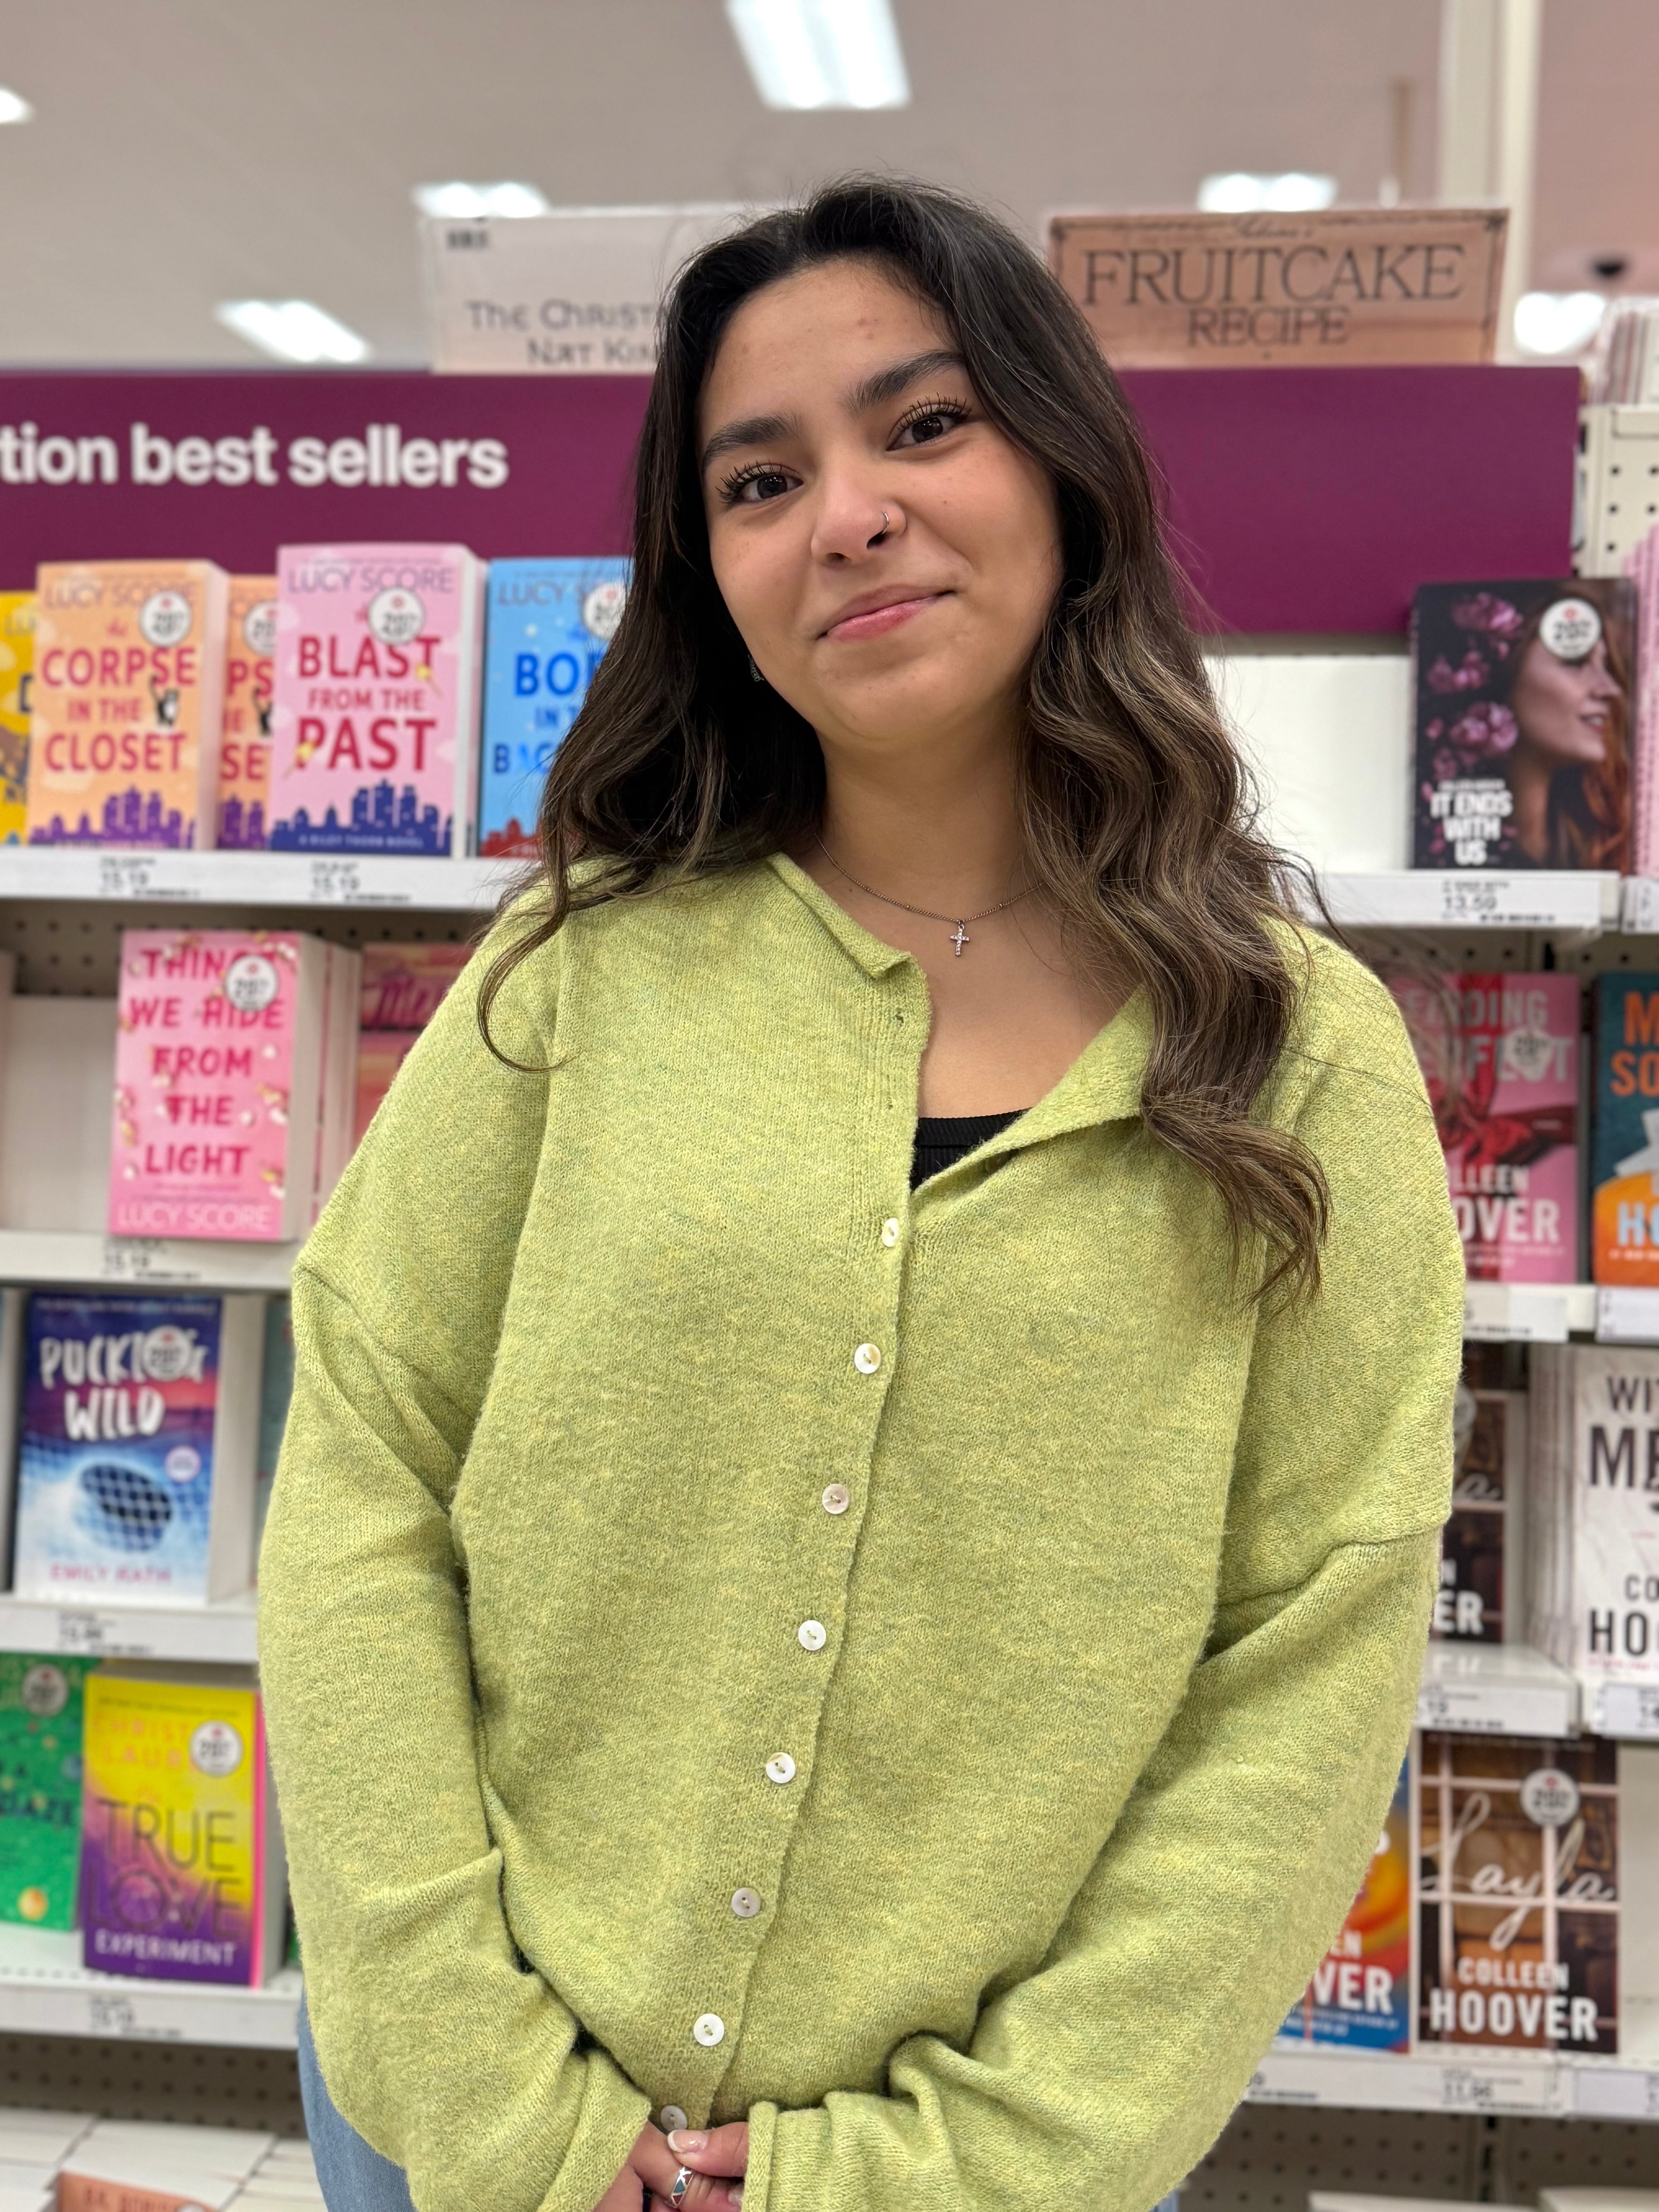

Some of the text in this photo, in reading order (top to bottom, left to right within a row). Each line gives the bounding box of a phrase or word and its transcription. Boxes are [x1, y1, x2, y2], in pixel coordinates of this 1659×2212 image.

[1084, 243, 1466, 307] FRUITCAKE
[1187, 304, 1351, 347] RECIPE
[131, 422, 279, 486] best
[288, 423, 510, 489] sellers
[288, 566, 454, 594] LUCY SCORE
[497, 580, 567, 606] LUCY
[42, 647, 196, 688] CORPSE
[298, 634, 442, 679] BLAST
[67, 697, 142, 724] IN THE
[308, 689, 426, 711] FROM THE
[535, 706, 560, 729] IN
[44, 732, 187, 772] CLOSET
[298, 717, 436, 772] PAST
[1430, 790, 1514, 819] IT ENDS
[1442, 816, 1501, 842] WITH
[1454, 838, 1488, 866] US
[140, 949, 275, 979] THIN
[130, 998, 181, 1028] WE
[151, 1047, 254, 1078] FROM
[163, 1095, 235, 1126] THE
[144, 1145, 250, 1177] LIGHT
[118, 1202, 272, 1232] LUCY SCORE
[39, 1327, 208, 1390] PUCKI
[64, 1386, 166, 1442] WILD
[1589, 1608, 1659, 1657] HO
[97, 1798, 235, 1872] TRUE
[1419, 1791, 1617, 1952] Layla
[88, 1863, 244, 1939] LOVE
[94, 1927, 237, 1967] EXPERIMENT
[1457, 1956, 1570, 1990] COLLEEN
[1429, 1987, 1599, 2042] HOOVER
